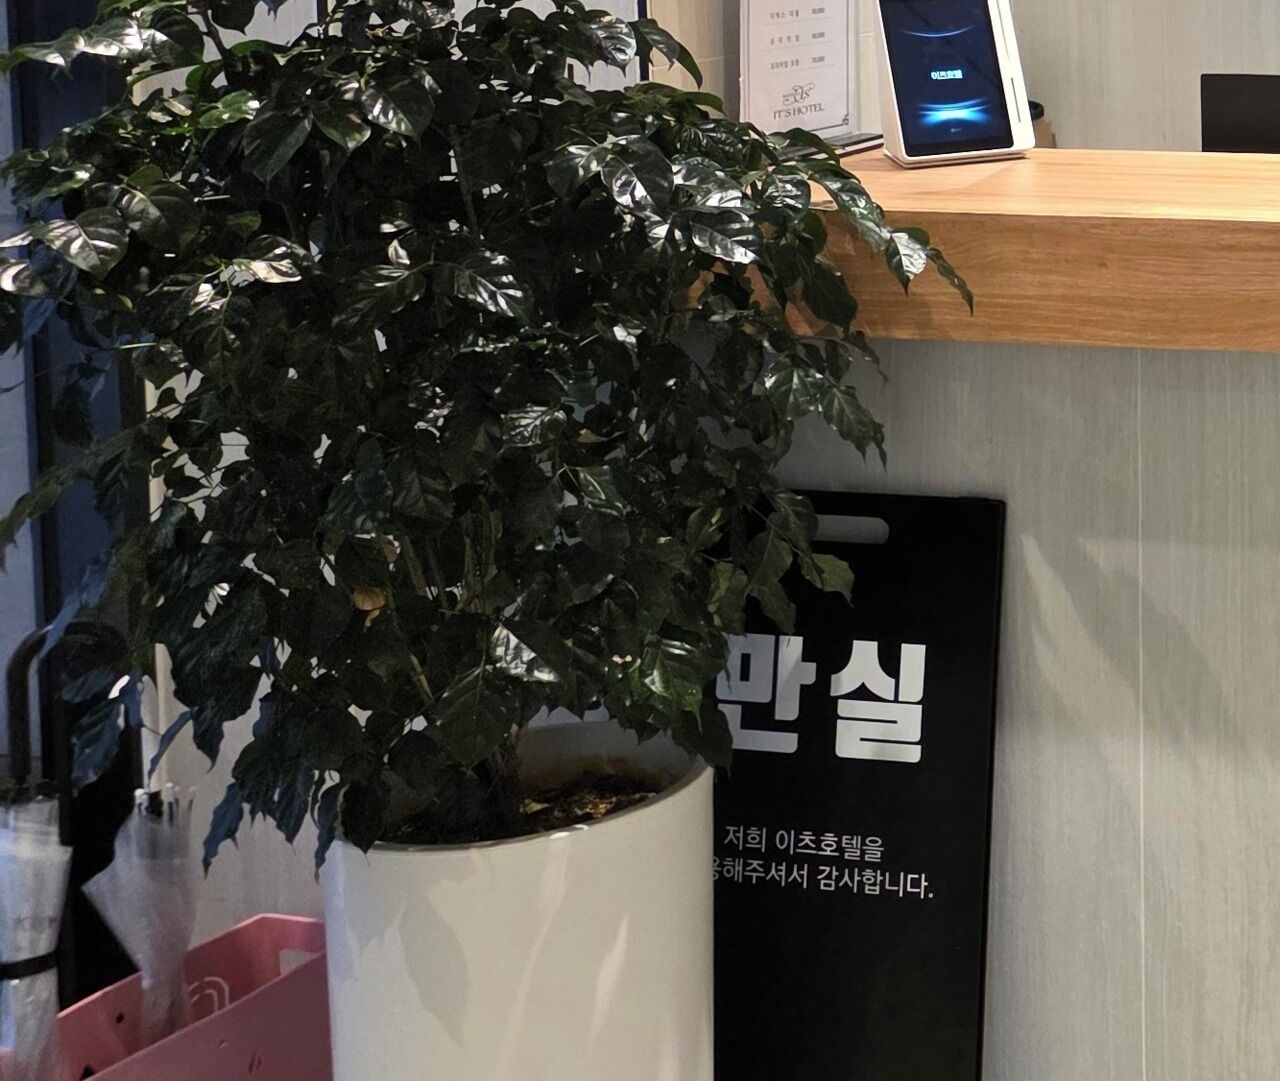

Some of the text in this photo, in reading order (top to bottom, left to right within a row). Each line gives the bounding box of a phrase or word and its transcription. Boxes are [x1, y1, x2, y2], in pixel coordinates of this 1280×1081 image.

[793, 103, 825, 117] HOTEL
[715, 632, 927, 764] 만실
[724, 825, 885, 862] 저희 이츠호텔을
[817, 865, 934, 900] 감사합니다.
